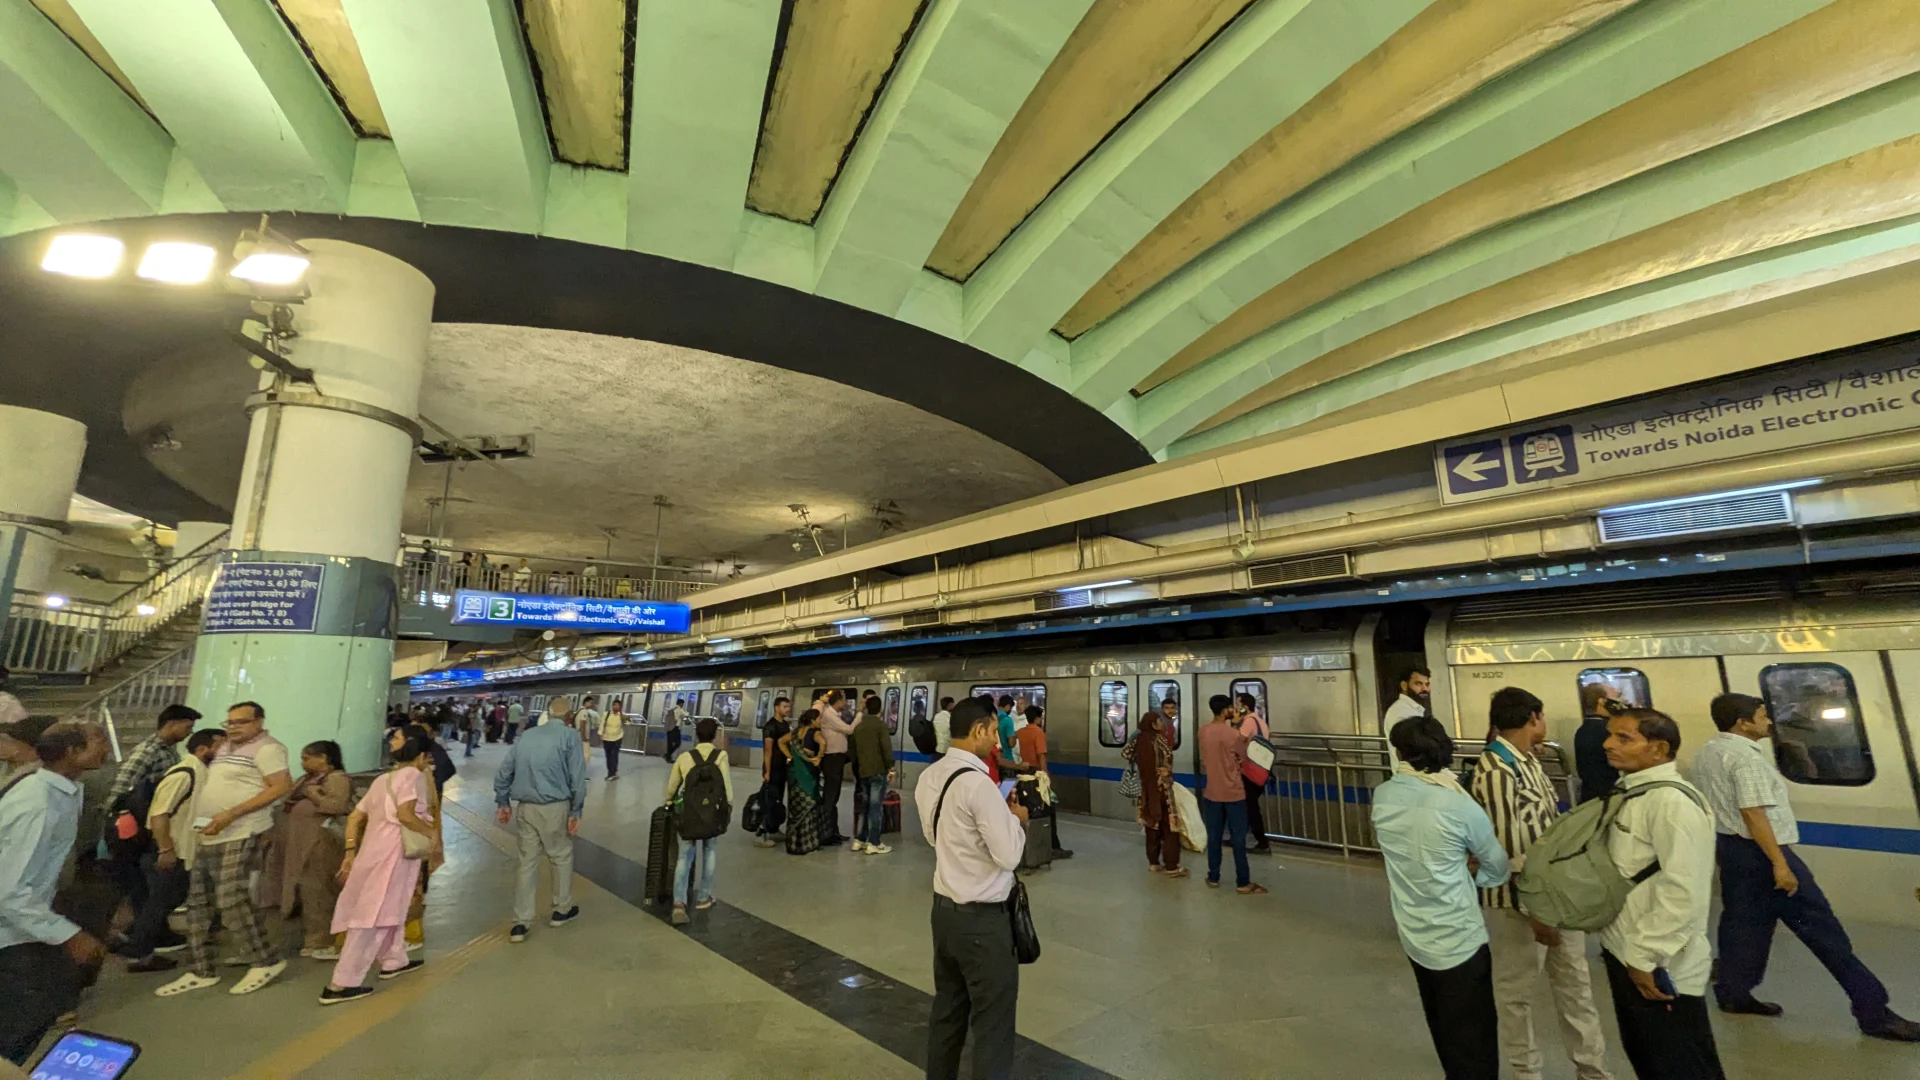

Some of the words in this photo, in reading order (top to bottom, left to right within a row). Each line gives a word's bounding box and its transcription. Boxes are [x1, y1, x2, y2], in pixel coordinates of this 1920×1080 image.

[1581, 421, 1637, 442] नोएडा
[1585, 438, 1678, 464] Towards
[1685, 424, 1754, 446] Noida
[1761, 397, 1904, 432] Electronic
[251, 600, 279, 609] Bridge
[494, 601, 509, 617] 3
[517, 600, 541, 610] नोएडा
[643, 606, 656, 615] ओर
[516, 612, 552, 620] Towards
[579, 615, 617, 624] Electronic
[618, 616, 666, 626] City/Vaishali
